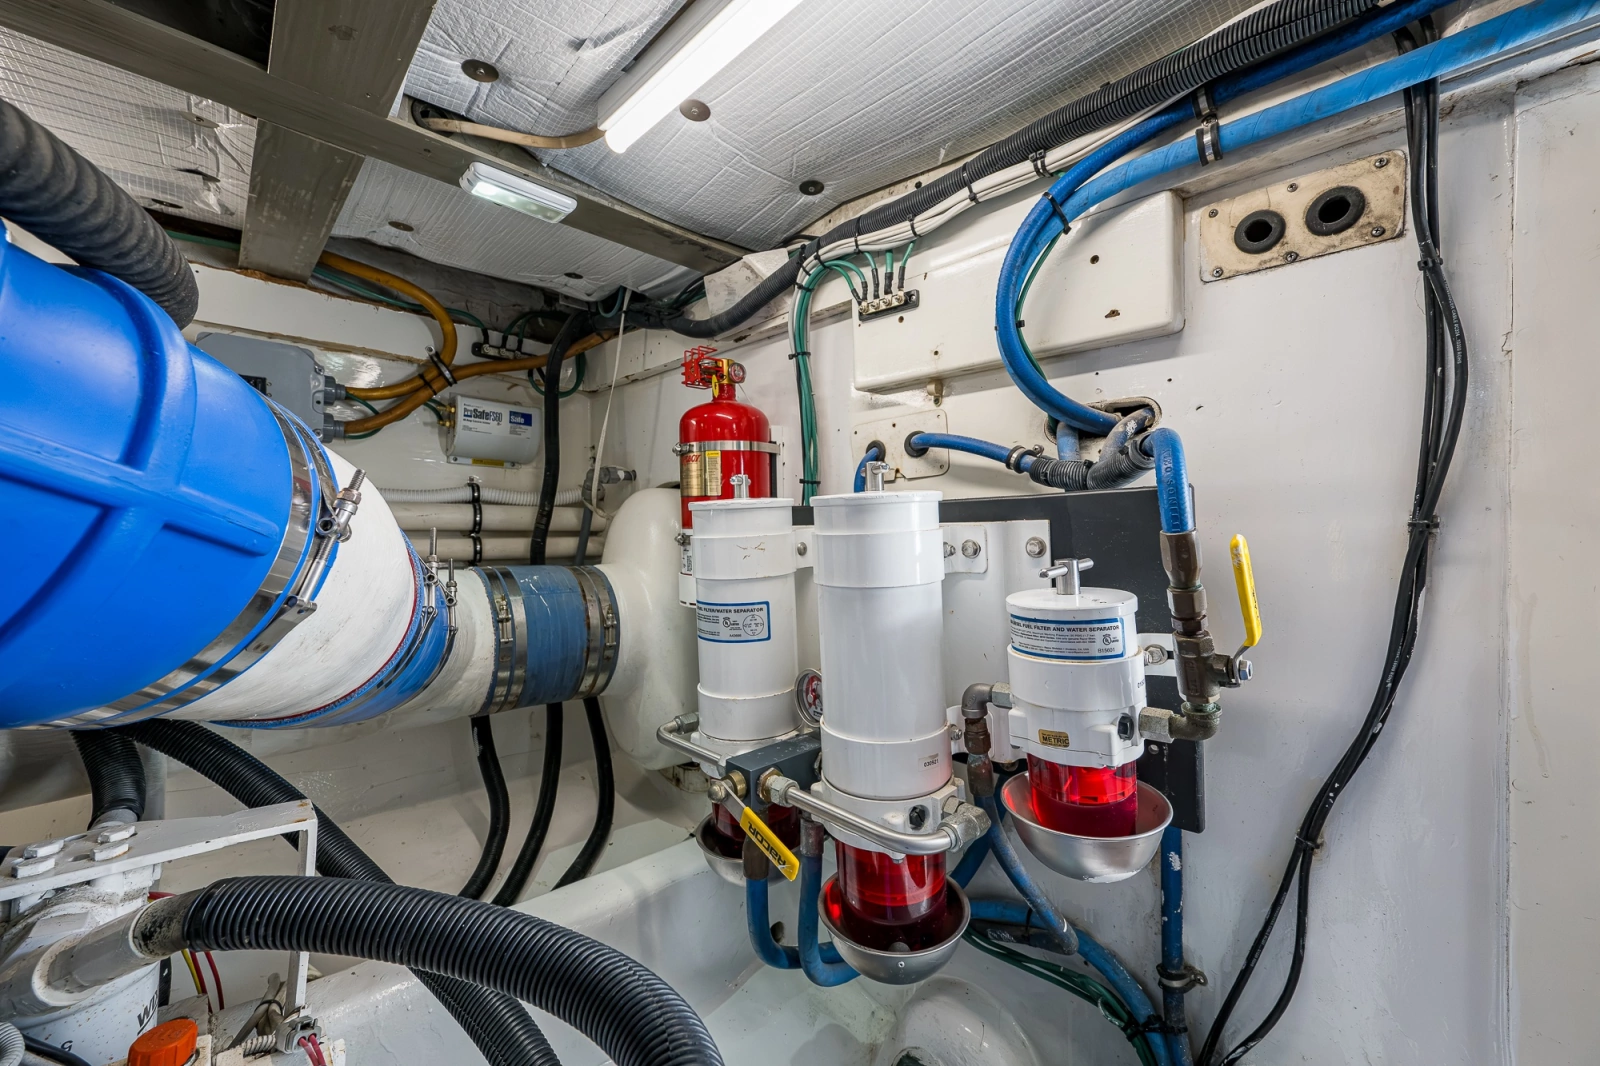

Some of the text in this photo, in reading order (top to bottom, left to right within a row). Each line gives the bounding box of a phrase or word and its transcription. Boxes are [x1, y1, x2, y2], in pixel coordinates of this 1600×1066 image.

[733, 606, 764, 614] SEPARATOR
[1089, 624, 1120, 633] SEPARATOR
[1042, 735, 1070, 744] METRIC
